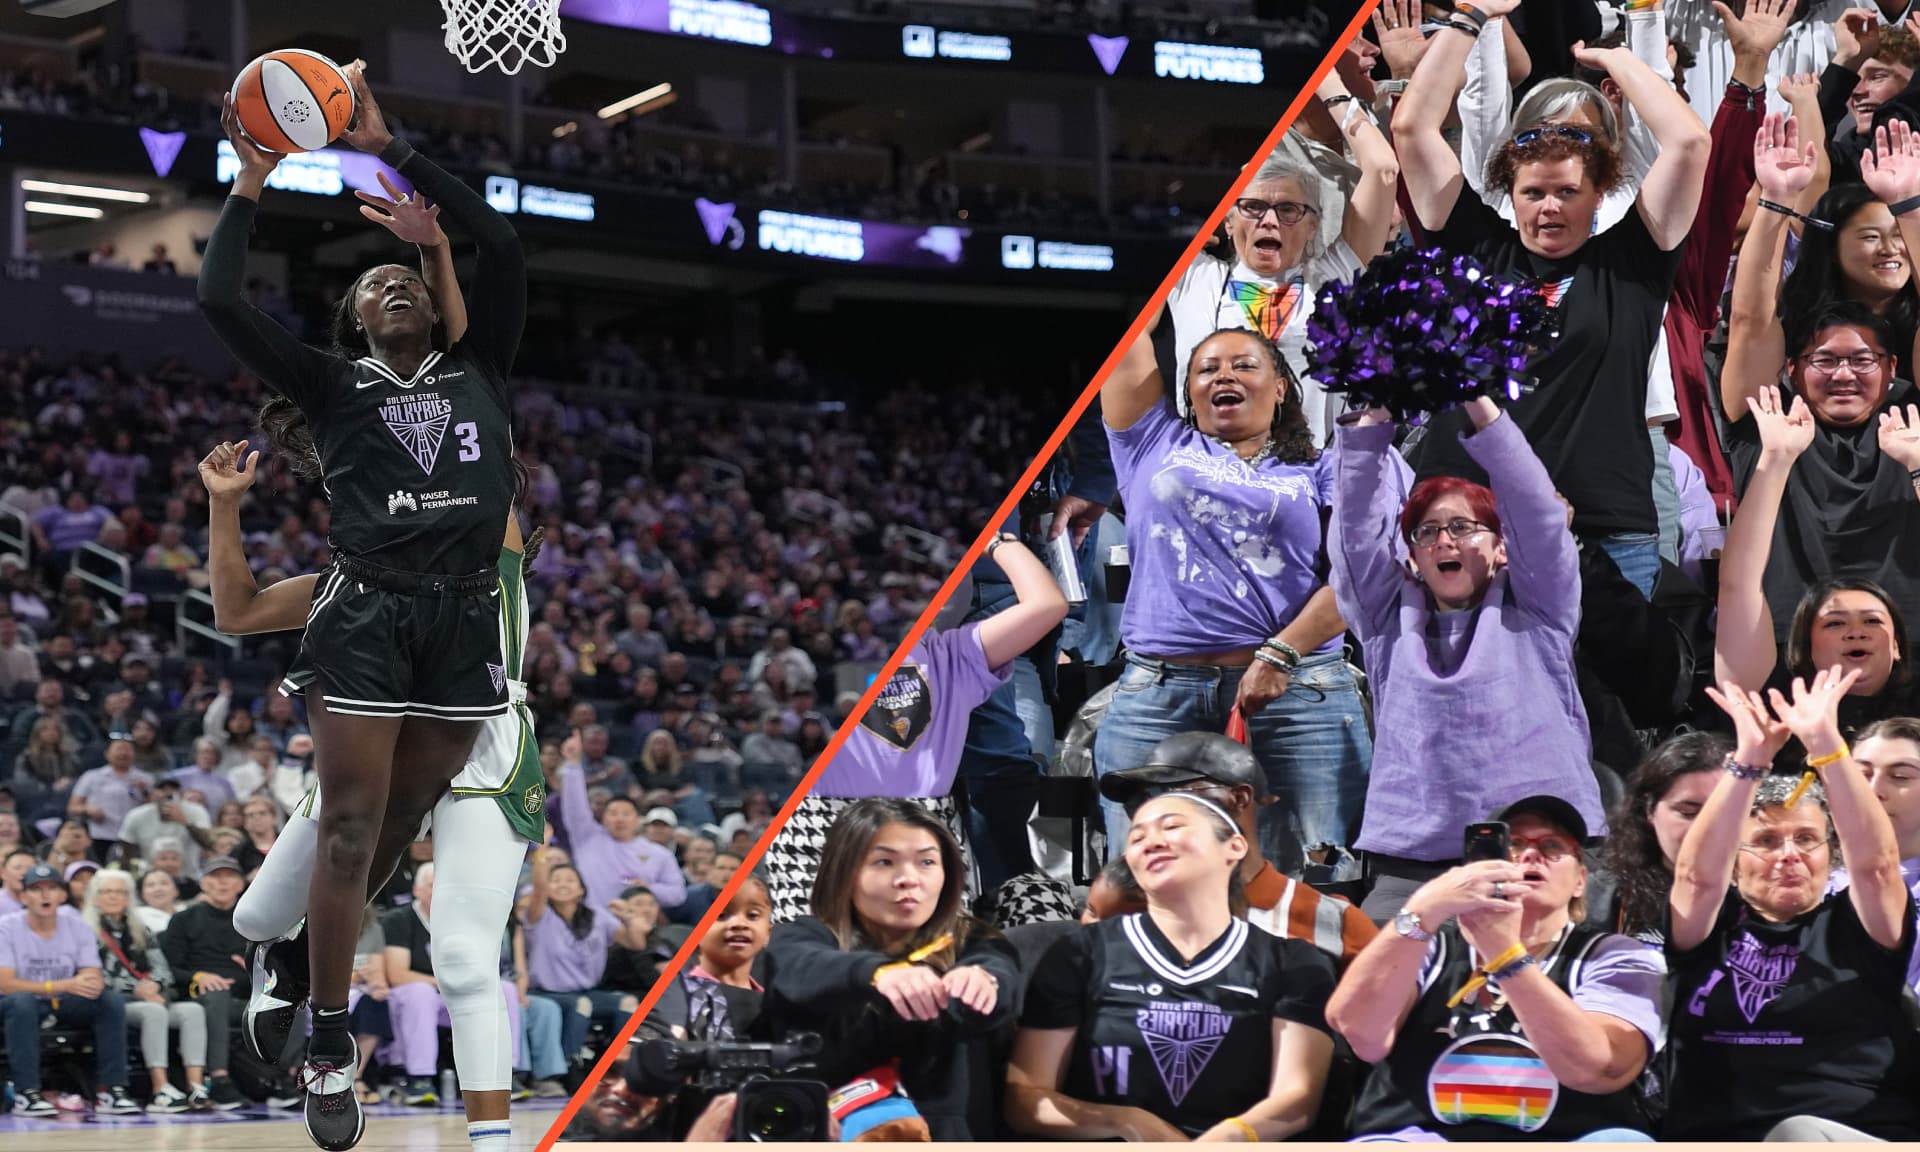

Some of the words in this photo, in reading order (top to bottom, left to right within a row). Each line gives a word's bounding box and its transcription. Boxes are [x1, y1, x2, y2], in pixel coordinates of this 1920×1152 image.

[1155, 53, 1264, 84] FUTURES
[758, 224, 865, 262] FUTURES
[386, 394, 416, 405] GOLDEN
[416, 392, 441, 402] STATE
[378, 399, 452, 423] VALKYRIES
[454, 421, 481, 462] 3
[420, 490, 450, 500] KAISER
[422, 496, 479, 509] PERMANENTE
